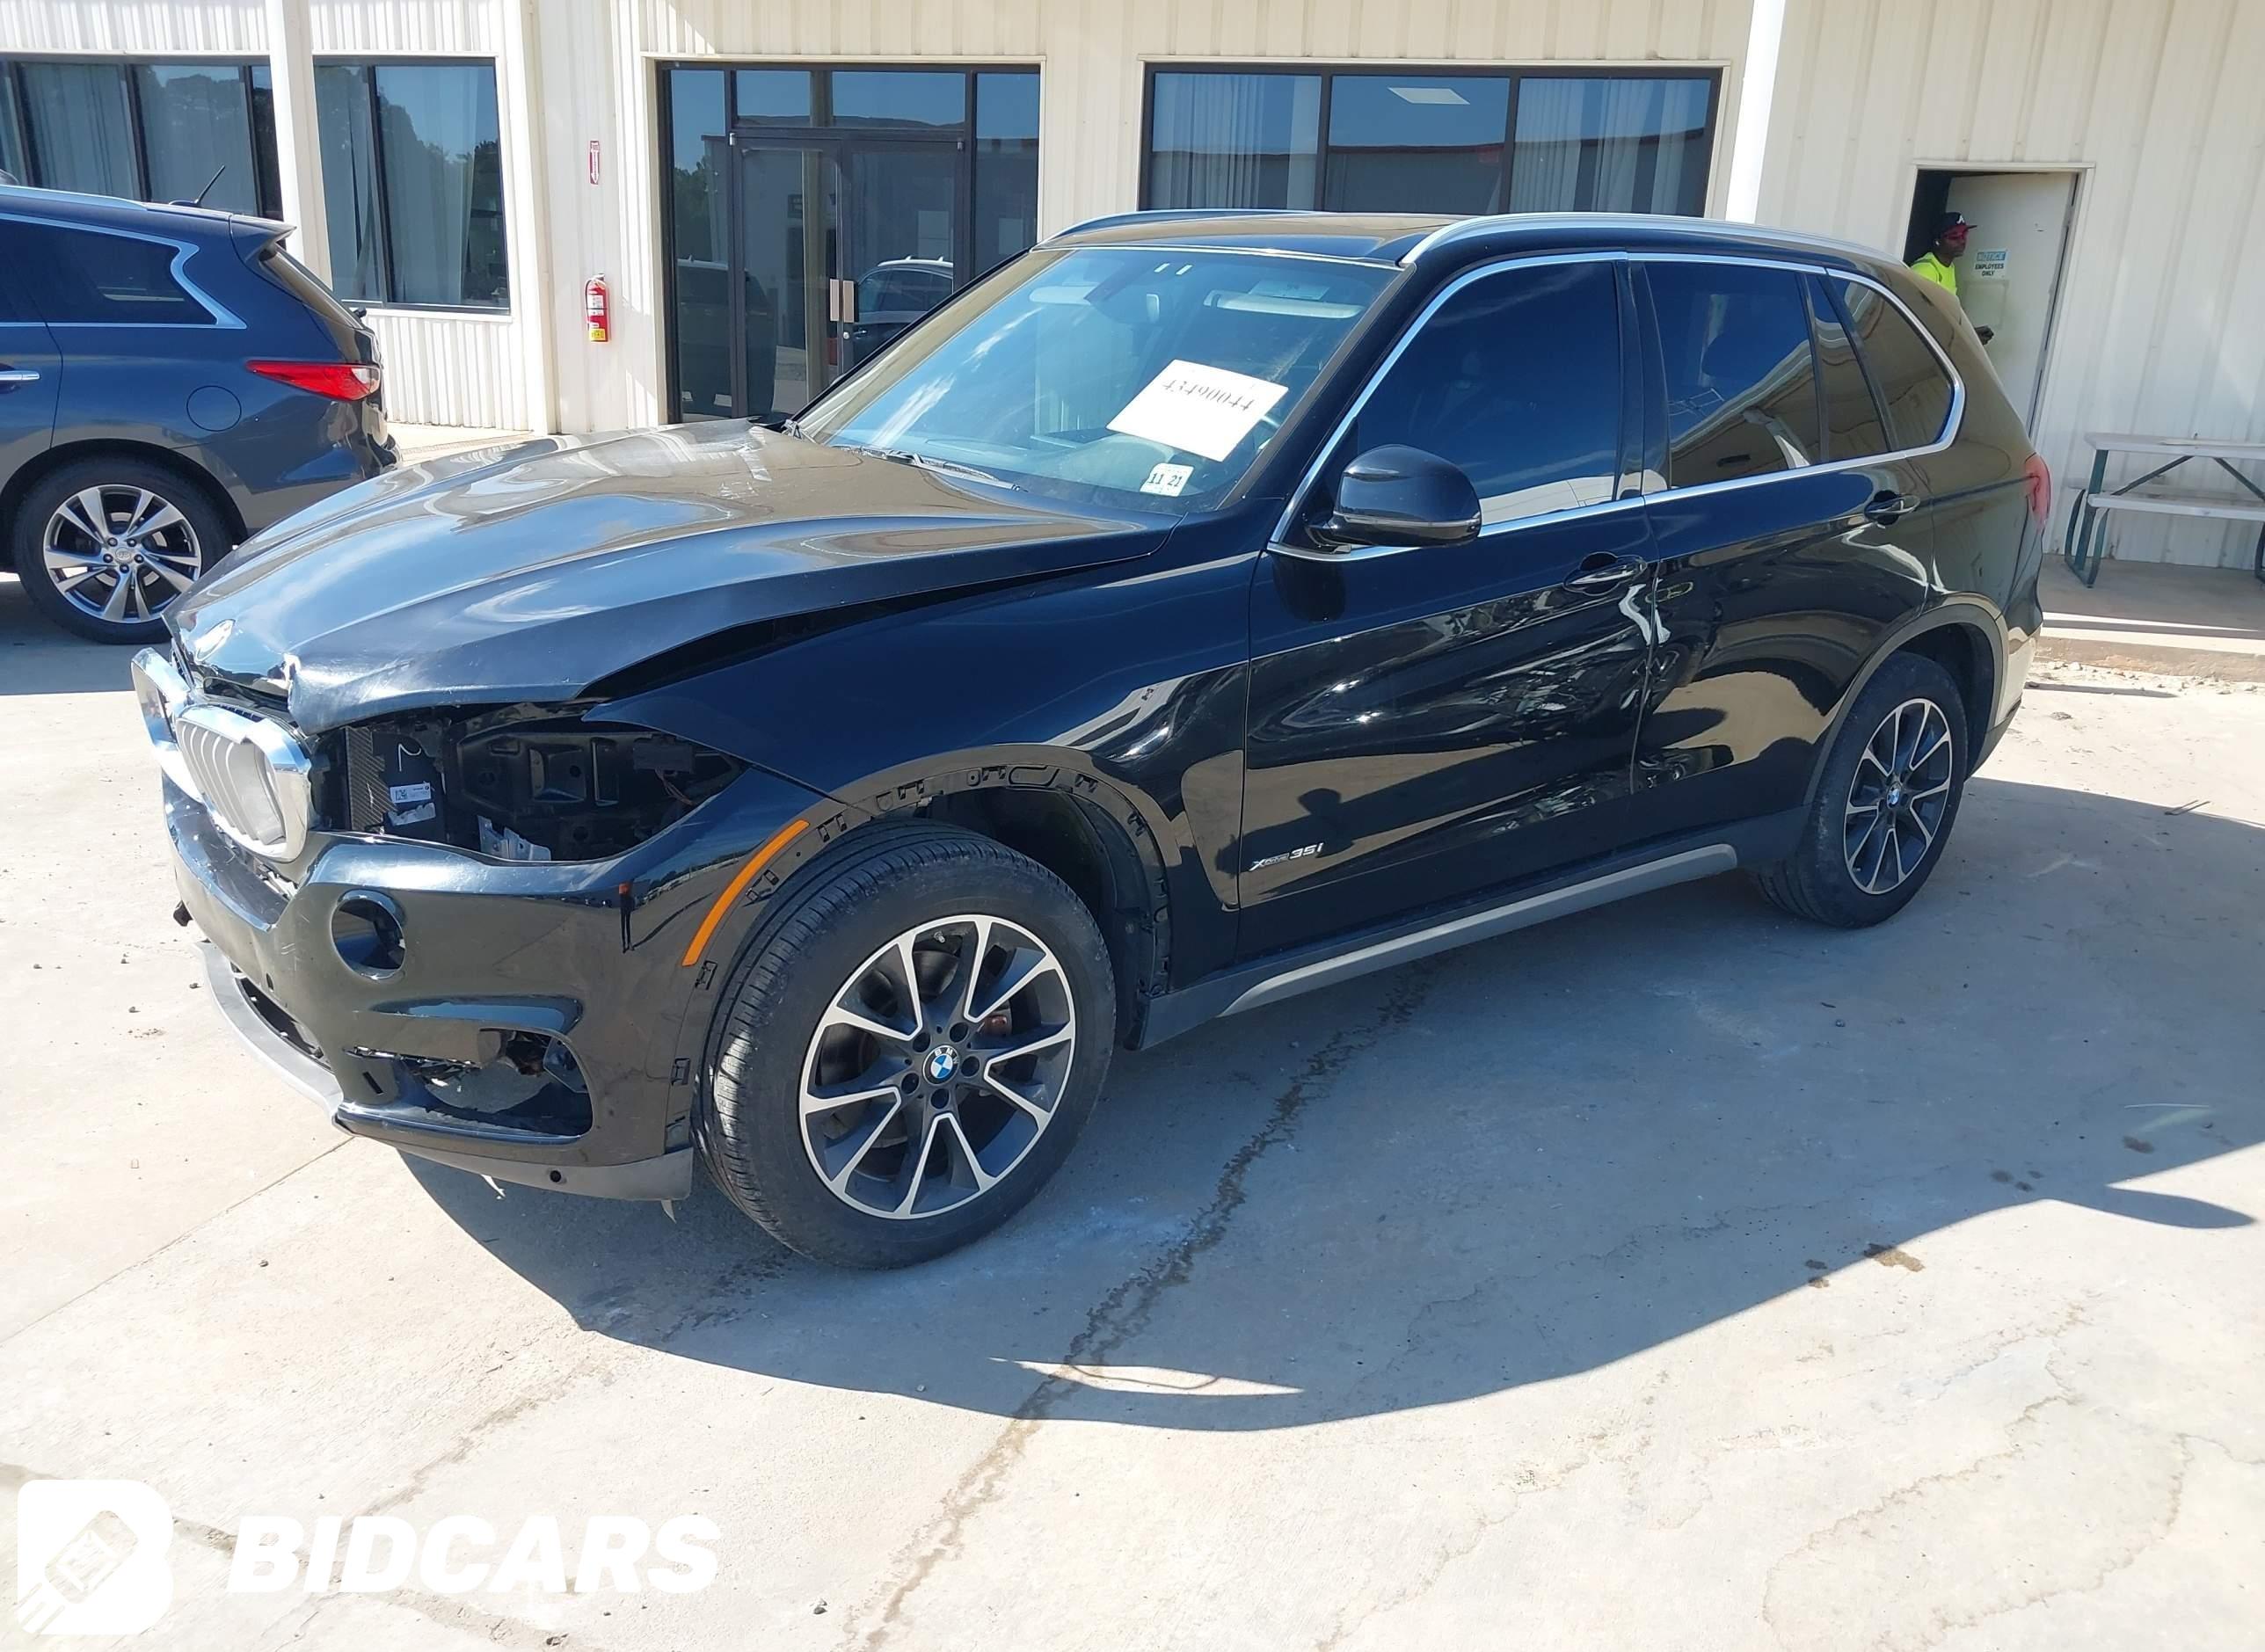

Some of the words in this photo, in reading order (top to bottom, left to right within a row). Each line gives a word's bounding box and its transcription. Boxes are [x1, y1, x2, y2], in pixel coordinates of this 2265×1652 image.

[1162, 380, 1255, 411] 43490044
[1147, 473, 1164, 484] 11
[1168, 475, 1183, 486] 21
[935, 1047, 958, 1064] BMW
